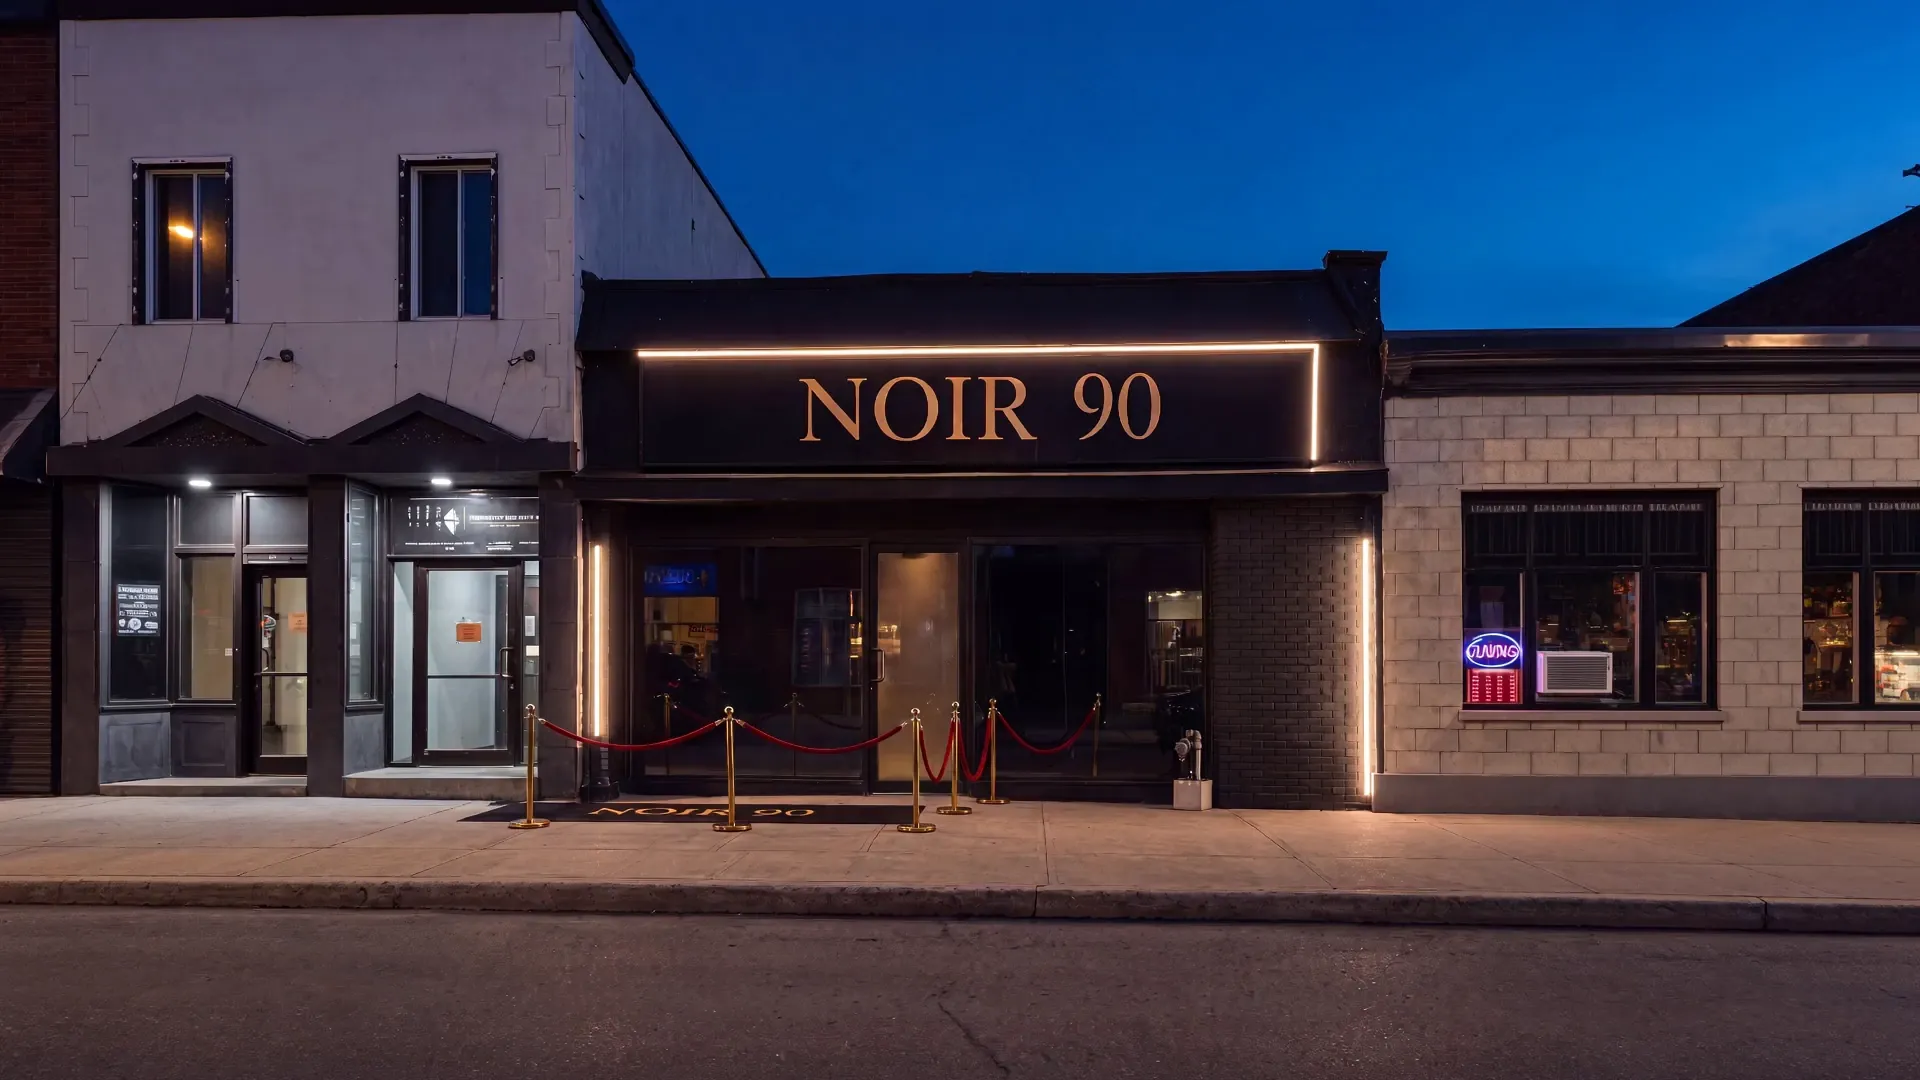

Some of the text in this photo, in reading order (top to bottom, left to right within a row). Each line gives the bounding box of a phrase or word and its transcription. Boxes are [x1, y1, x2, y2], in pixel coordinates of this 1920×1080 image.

[799, 372, 1161, 442] NOIR 90
[588, 807, 815, 817] NOIR 90
